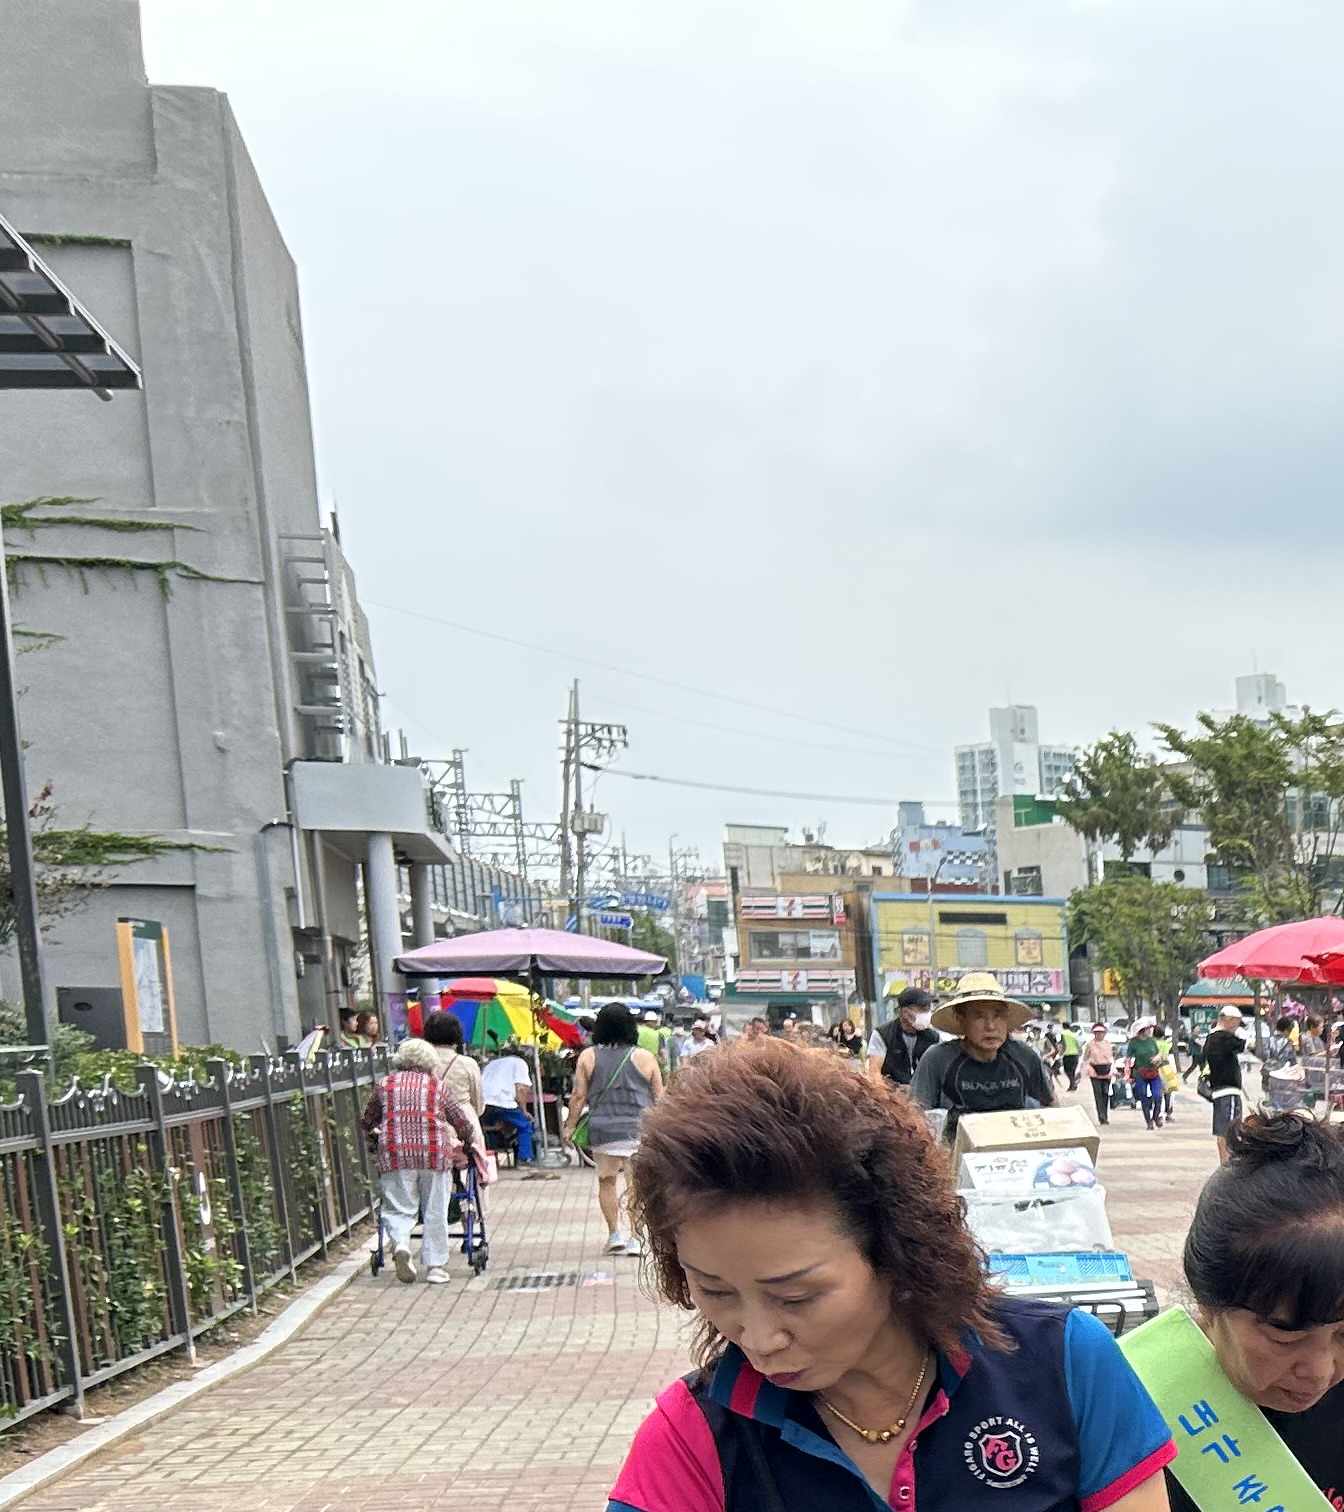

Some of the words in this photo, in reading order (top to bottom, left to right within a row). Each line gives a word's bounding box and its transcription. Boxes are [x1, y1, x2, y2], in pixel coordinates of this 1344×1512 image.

[968, 1416, 1003, 1439] SPORT
[1005, 1418, 1025, 1432] ALL
[1024, 1432, 1036, 1444] IS
[1025, 1446, 1040, 1472] WELL
